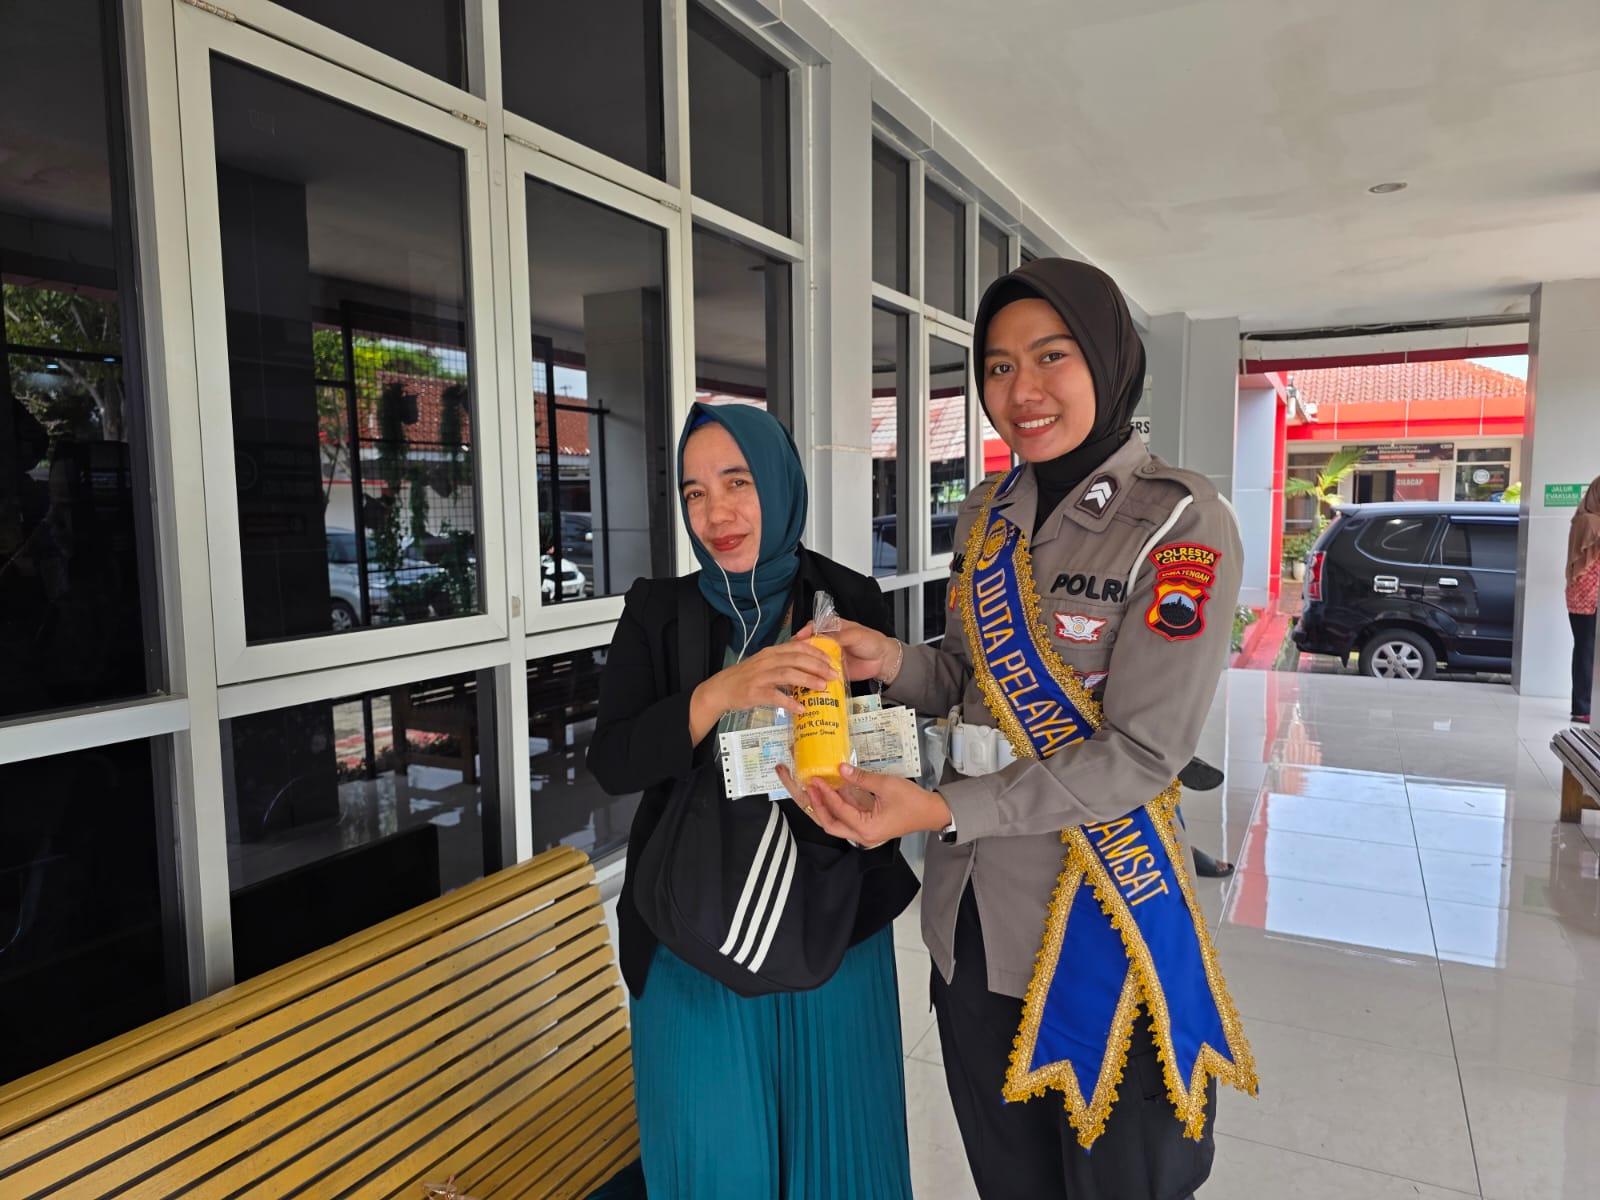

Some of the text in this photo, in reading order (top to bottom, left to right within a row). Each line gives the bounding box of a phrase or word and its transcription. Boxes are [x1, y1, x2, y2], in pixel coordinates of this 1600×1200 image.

[1129, 420, 1150, 434] RS
[1155, 547, 1215, 561] POLRESTA
[1161, 555, 1211, 564] CILACAP
[1181, 569, 1210, 583] TENGAH
[1050, 573, 1128, 603] POLRI
[976, 568, 1085, 758] DUTA PELAYA
[1083, 817, 1170, 907] AMSAT
